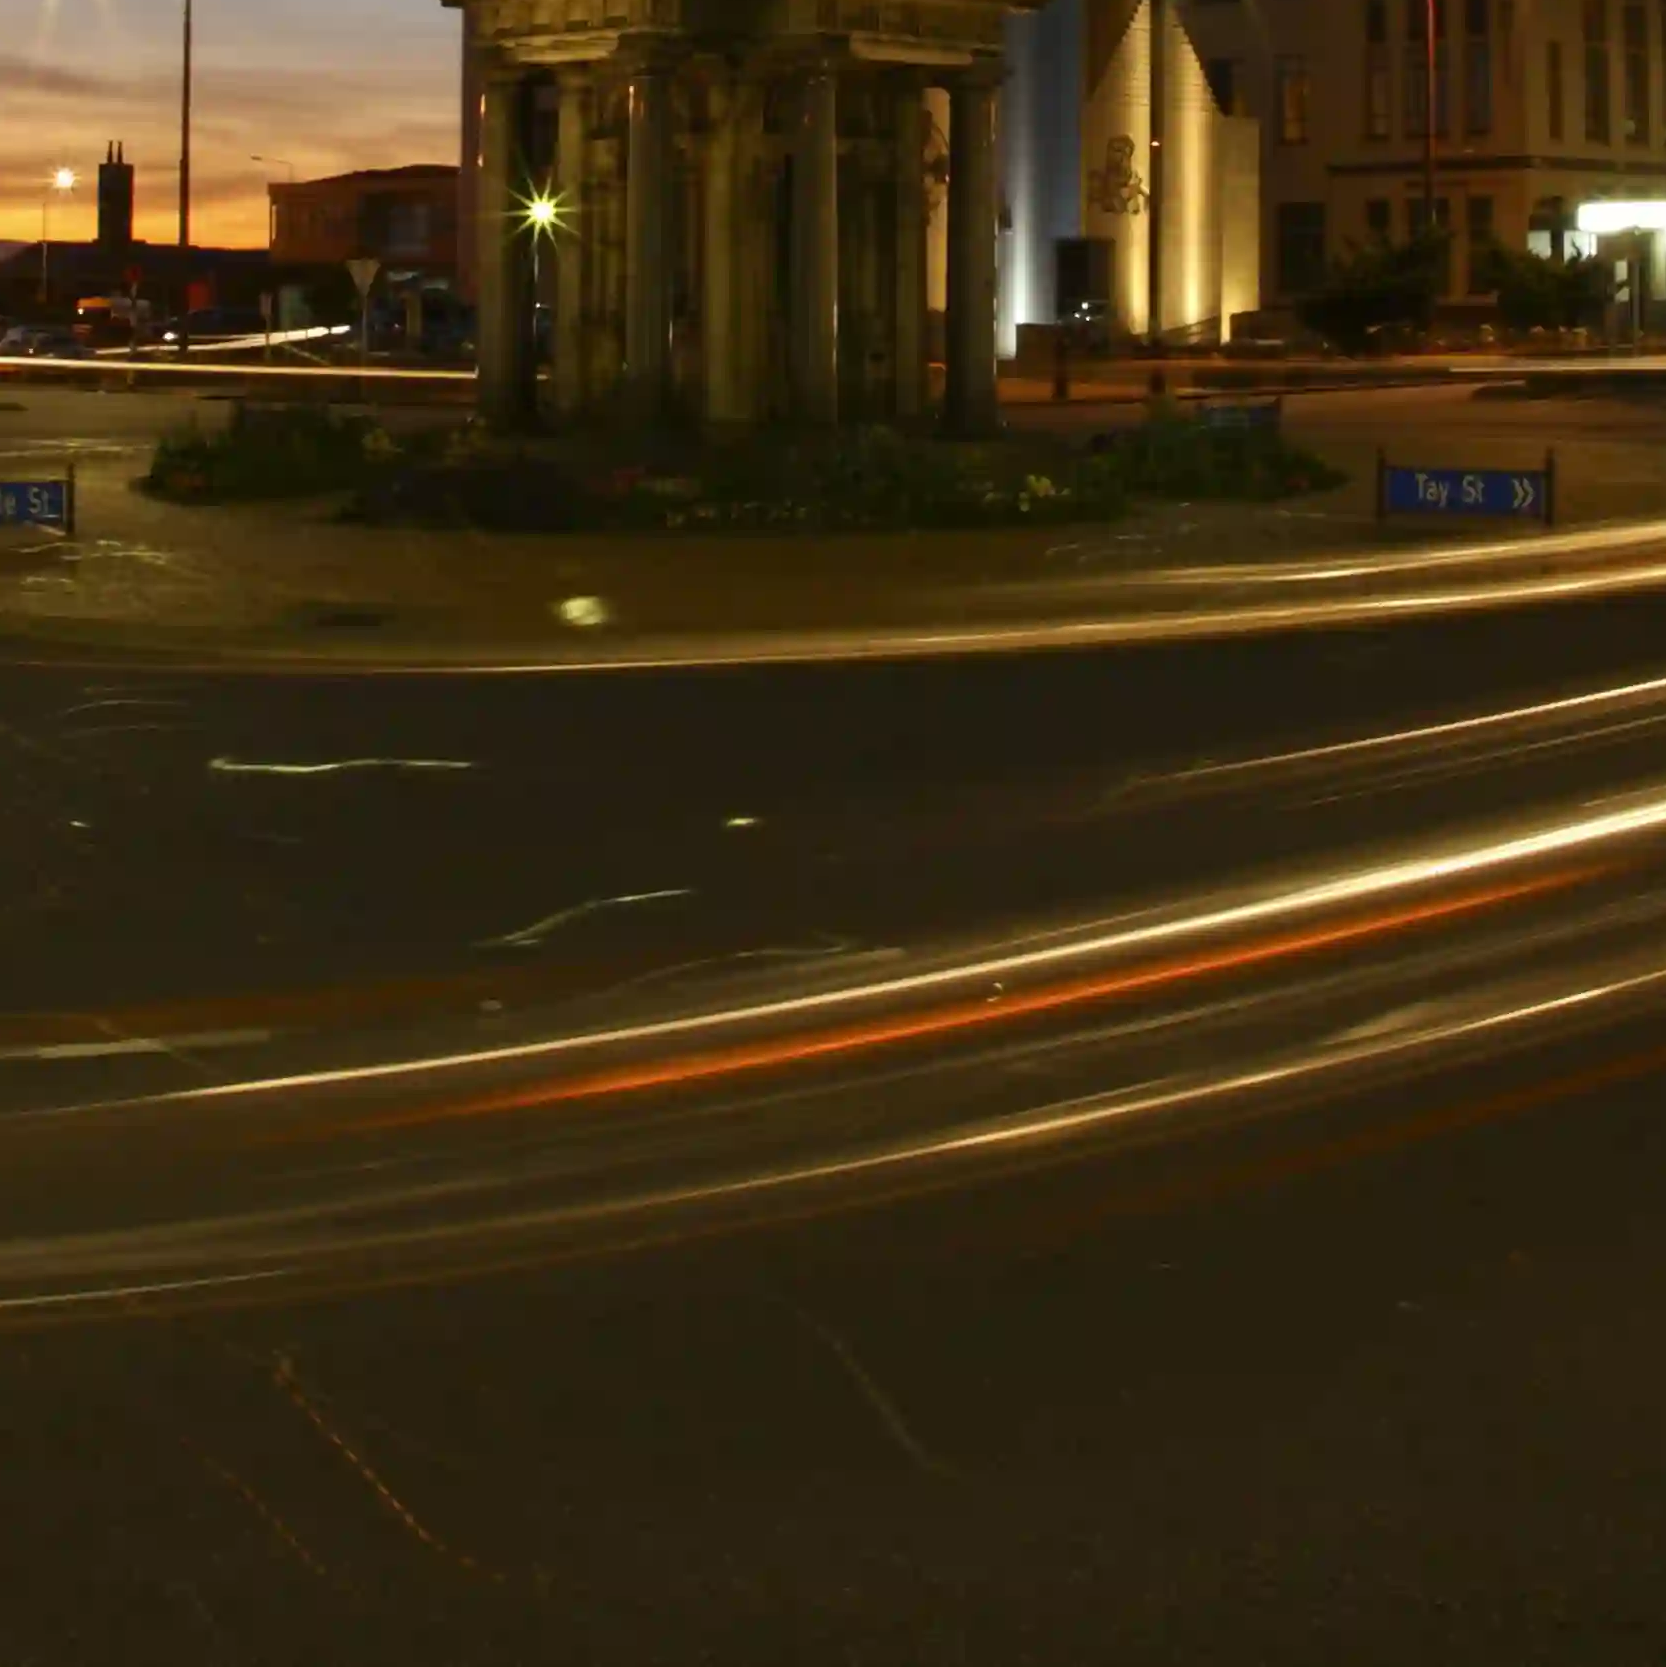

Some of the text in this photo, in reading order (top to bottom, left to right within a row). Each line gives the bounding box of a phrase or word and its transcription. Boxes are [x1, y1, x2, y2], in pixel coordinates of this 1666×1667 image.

[28, 487, 50, 513] St
[1415, 472, 1484, 507] Tay St
